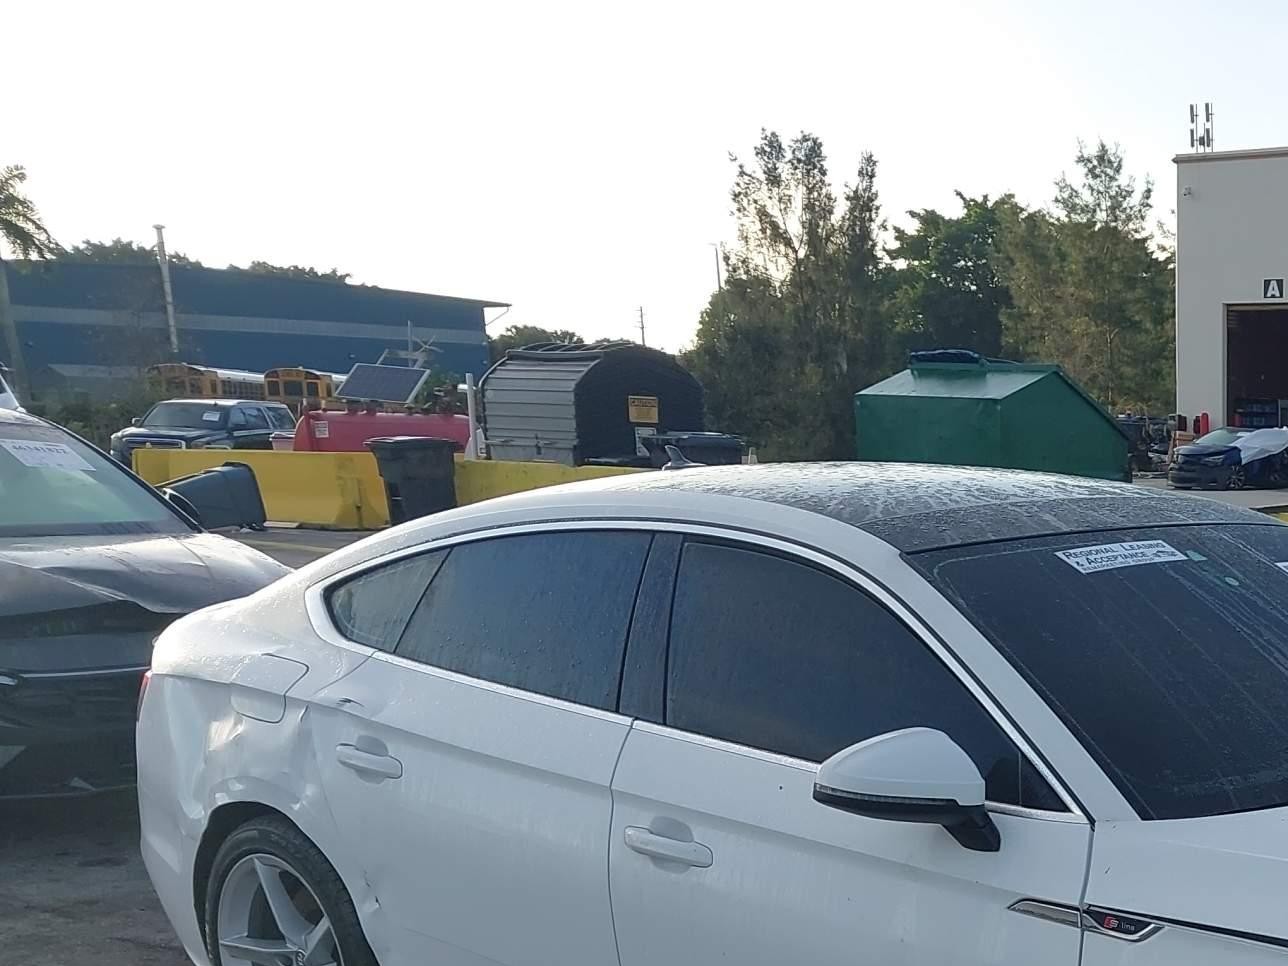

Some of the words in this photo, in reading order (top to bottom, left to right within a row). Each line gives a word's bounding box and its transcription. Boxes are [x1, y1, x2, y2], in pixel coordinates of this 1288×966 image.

[1266, 280, 1281, 298] A
[1062, 546, 1119, 559] REGIONAL
[1119, 542, 1167, 552] LEASING
[1085, 551, 1148, 565] ACCEPTANCE
